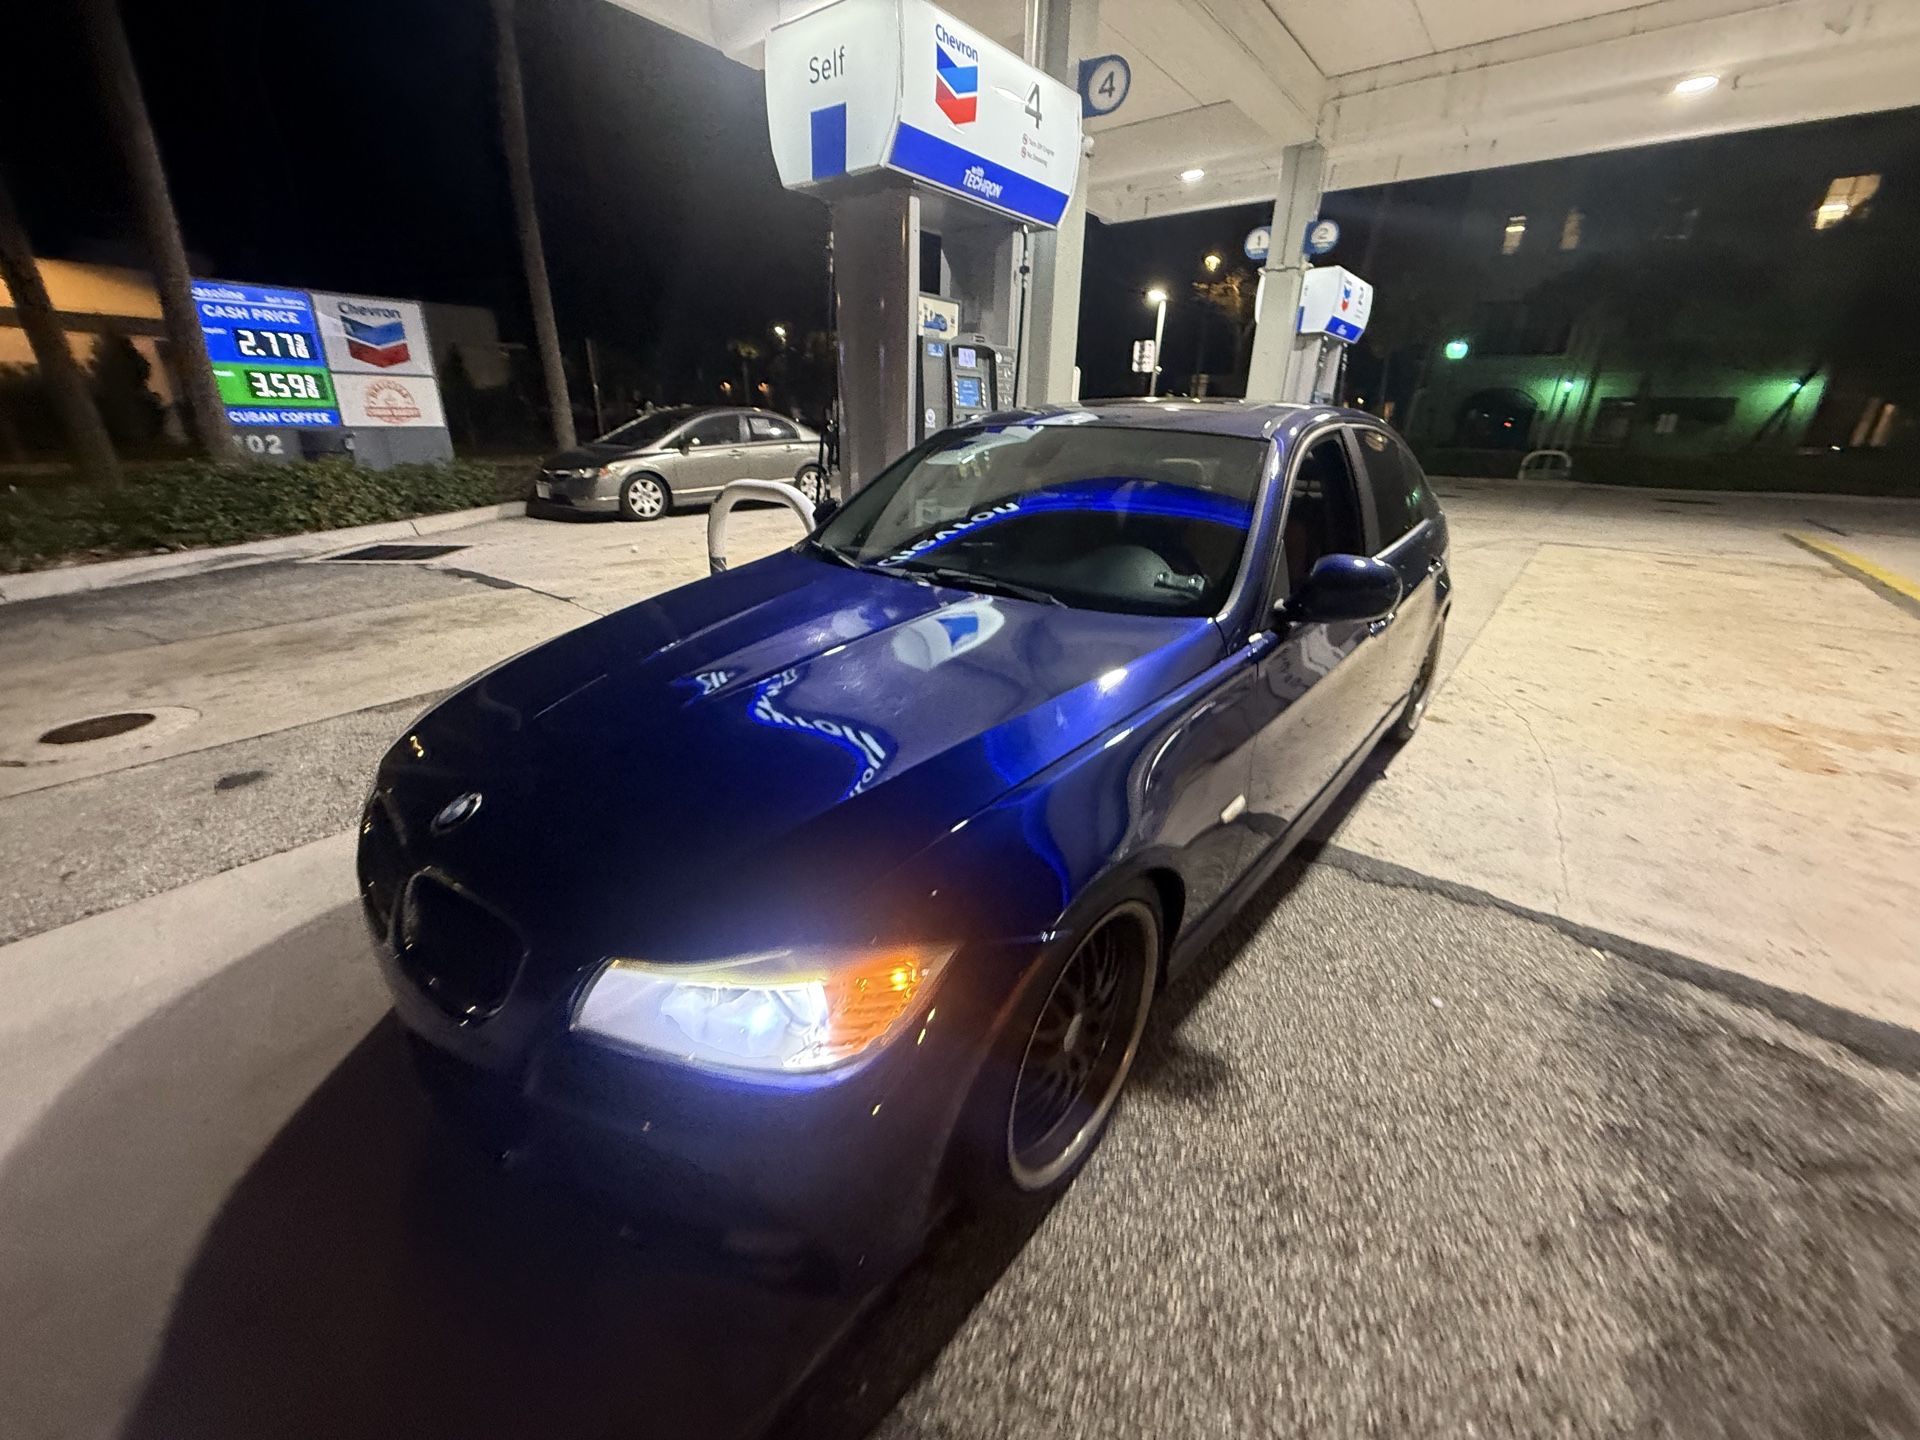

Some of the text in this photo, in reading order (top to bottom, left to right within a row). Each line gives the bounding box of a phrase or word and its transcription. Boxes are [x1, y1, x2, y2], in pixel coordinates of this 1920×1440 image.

[935, 23, 979, 63] Chevron
[808, 45, 845, 85] Self
[1098, 71, 1116, 98] 4
[1024, 82, 1043, 130] 4
[1318, 227, 1329, 240] 2
[202, 303, 301, 324] CASH PRICE
[337, 302, 402, 319] Chevron
[228, 411, 332, 424] CUBAN COFFEE
